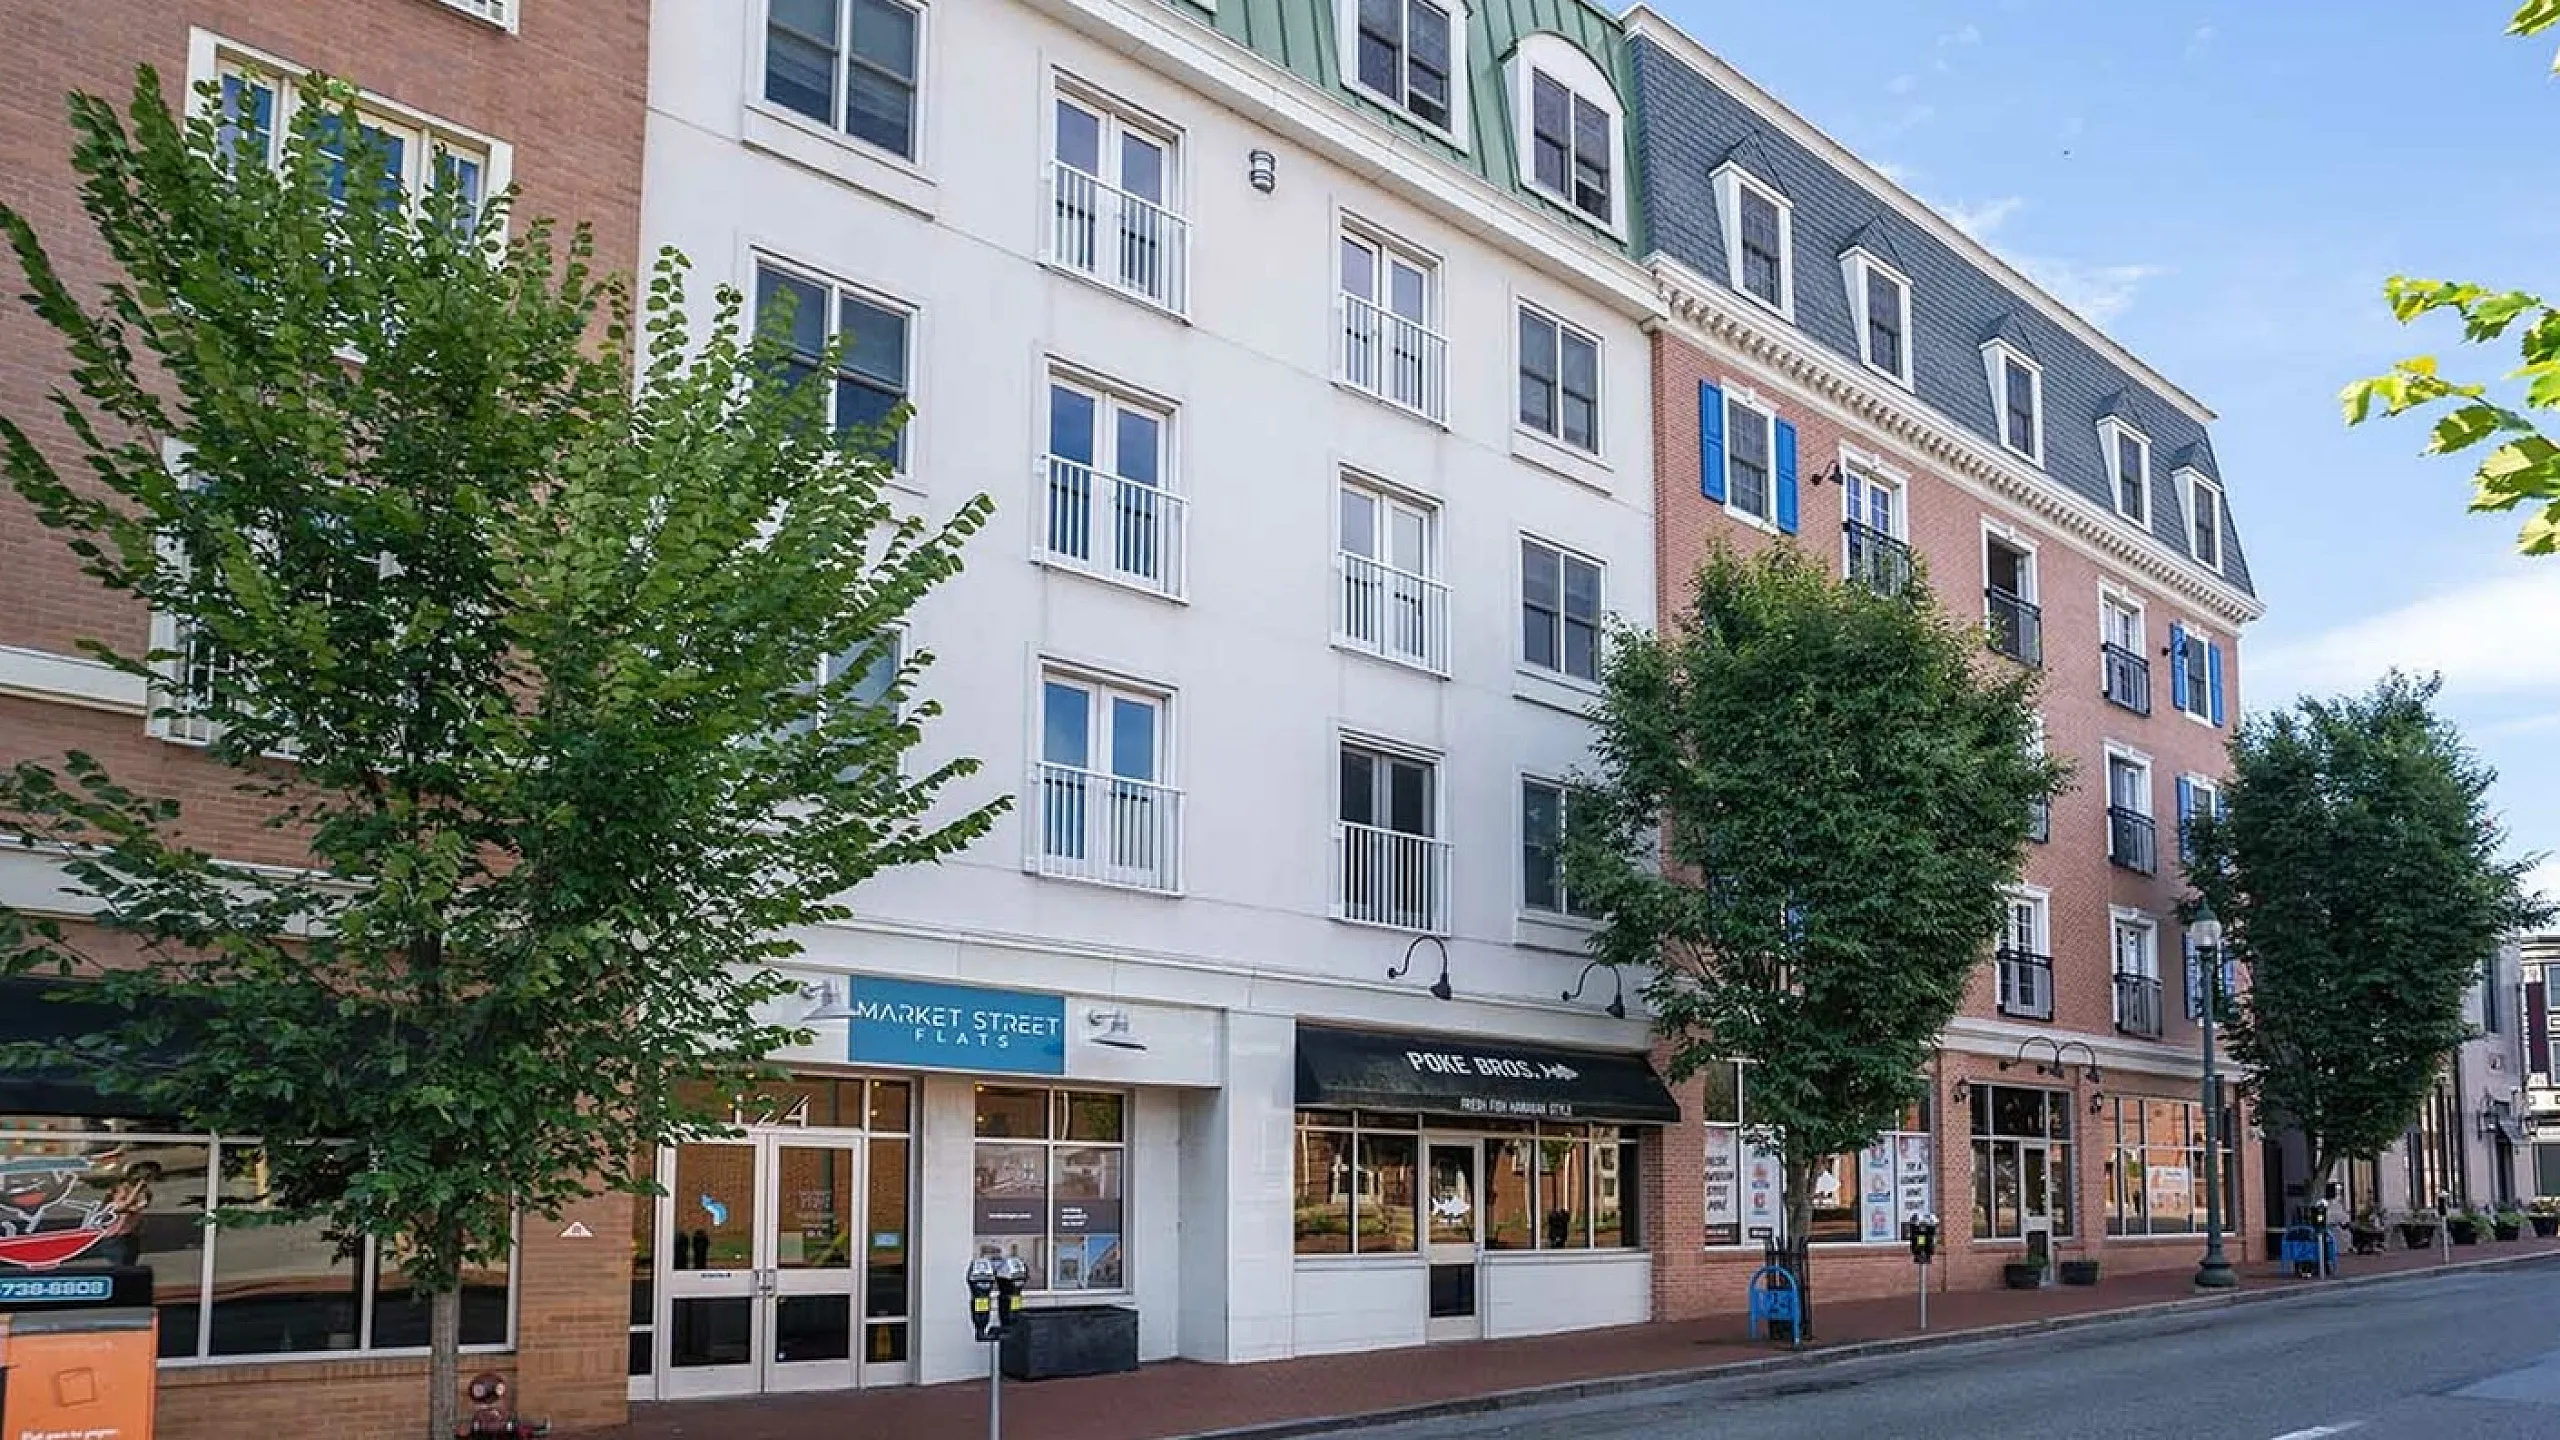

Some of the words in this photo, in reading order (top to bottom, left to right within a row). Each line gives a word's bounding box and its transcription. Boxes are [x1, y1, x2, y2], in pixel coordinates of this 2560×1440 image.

[858, 1001, 962, 1027] MARKET
[973, 1011, 1060, 1035] STREET
[914, 1027, 1009, 1049] FLATS
[1406, 1051, 1471, 1074] POKE
[1474, 1057, 1541, 1079] BROS.
